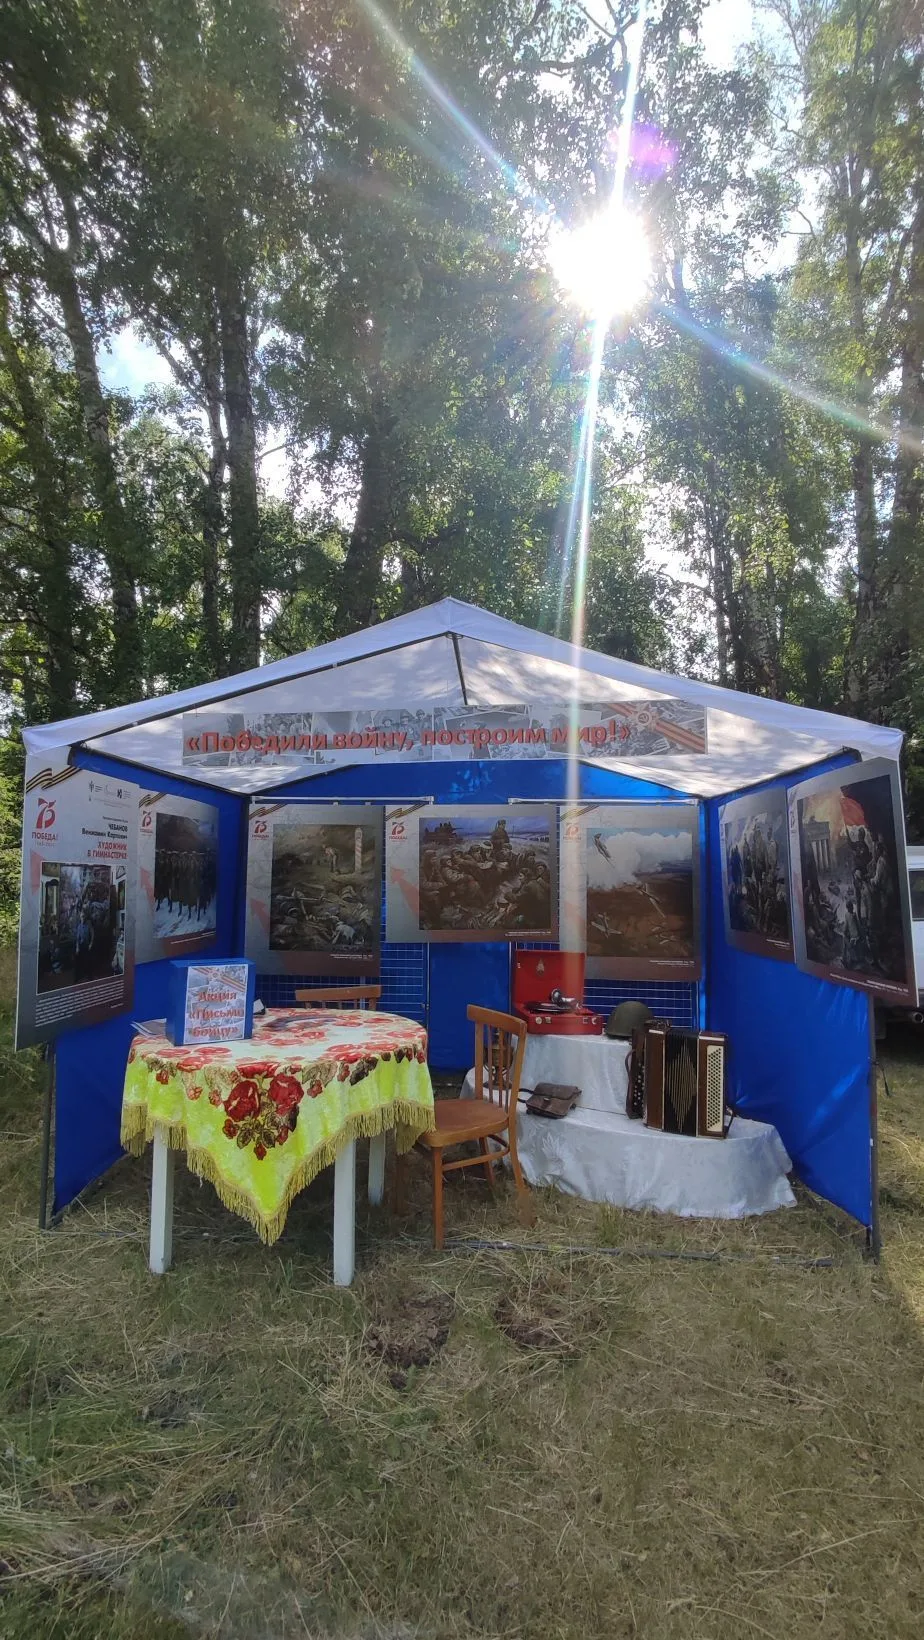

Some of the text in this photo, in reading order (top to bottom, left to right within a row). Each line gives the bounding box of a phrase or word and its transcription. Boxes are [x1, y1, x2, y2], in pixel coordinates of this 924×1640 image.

[186, 719, 631, 754] «Победили войну, построим мир!»
